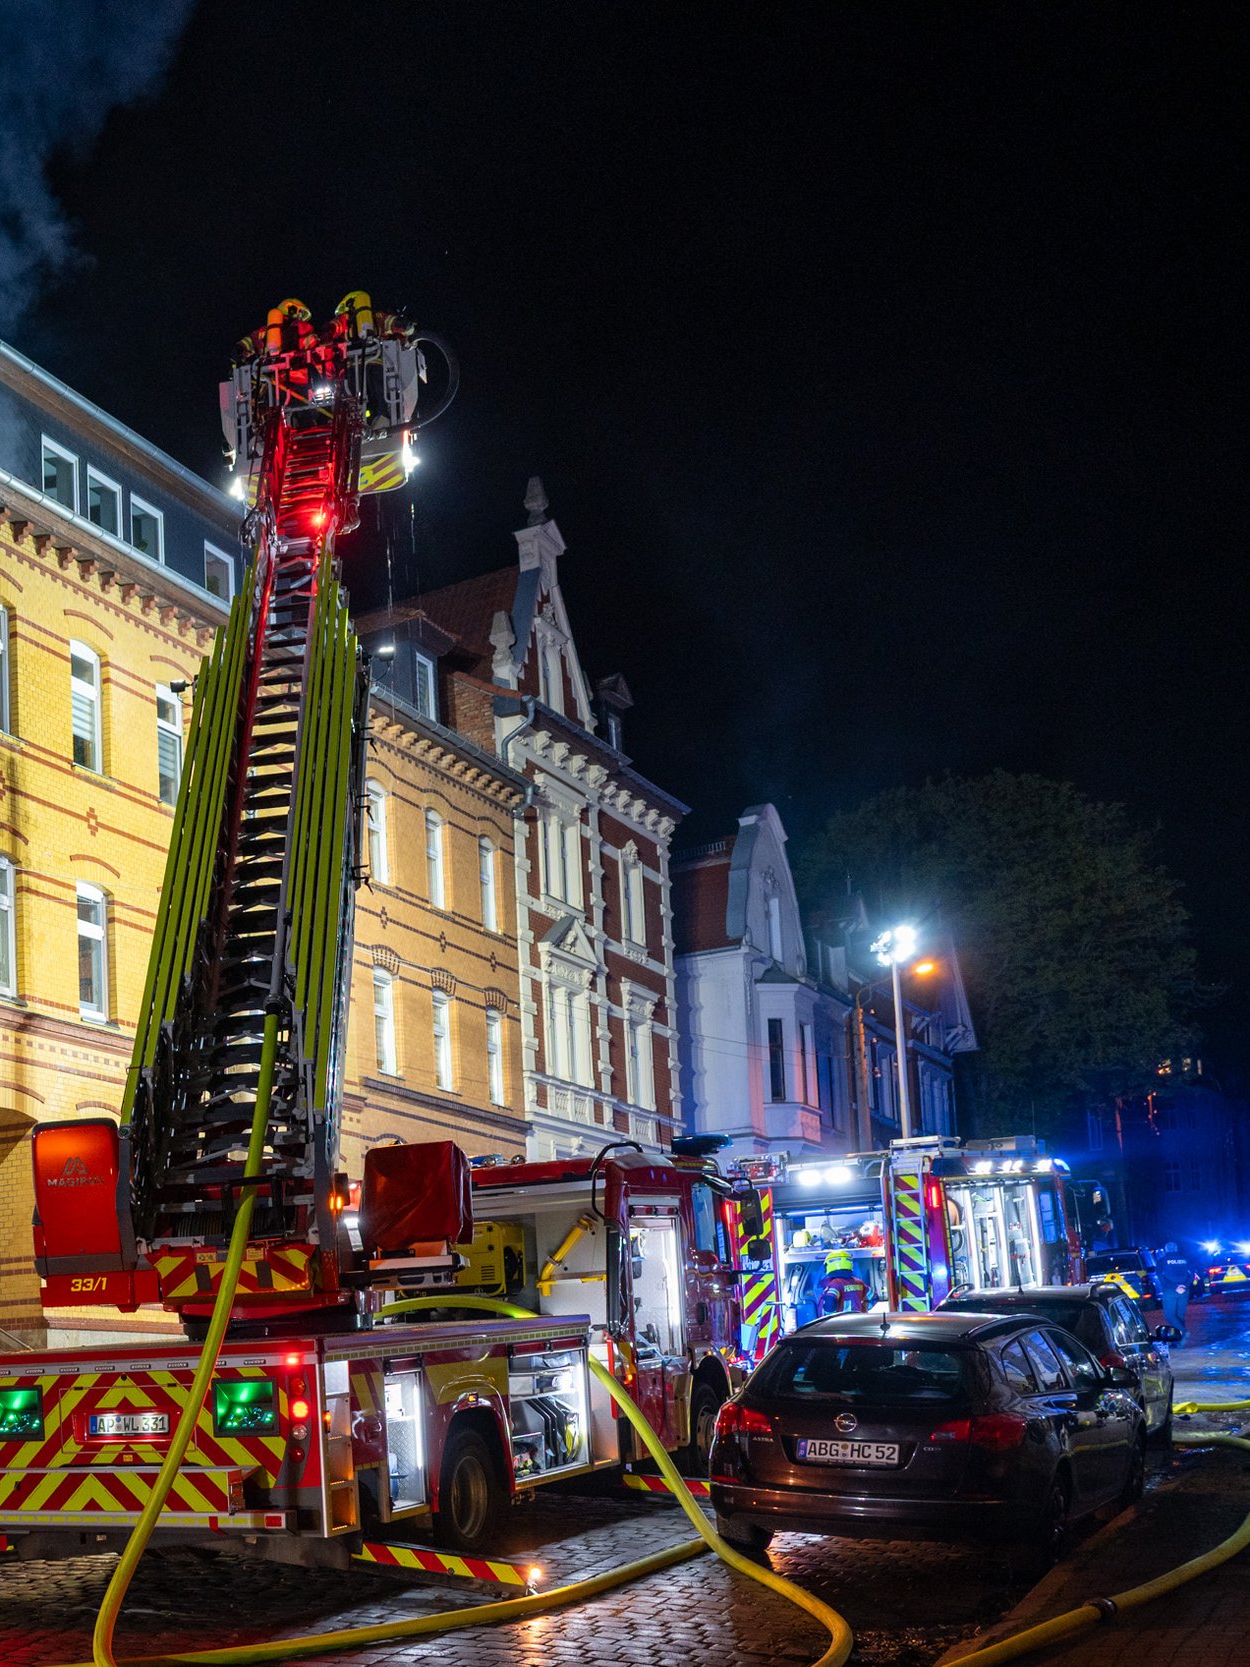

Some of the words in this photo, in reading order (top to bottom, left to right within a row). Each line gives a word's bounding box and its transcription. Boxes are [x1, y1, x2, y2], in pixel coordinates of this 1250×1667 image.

[71, 1276, 107, 1292] 33/1
[98, 1418, 115, 1433] AP
[123, 1417, 139, 1431] WL
[142, 1416, 166, 1431] 331
[807, 1442, 839, 1457] ABG
[850, 1443, 871, 1459] HC
[875, 1445, 896, 1461] 52
